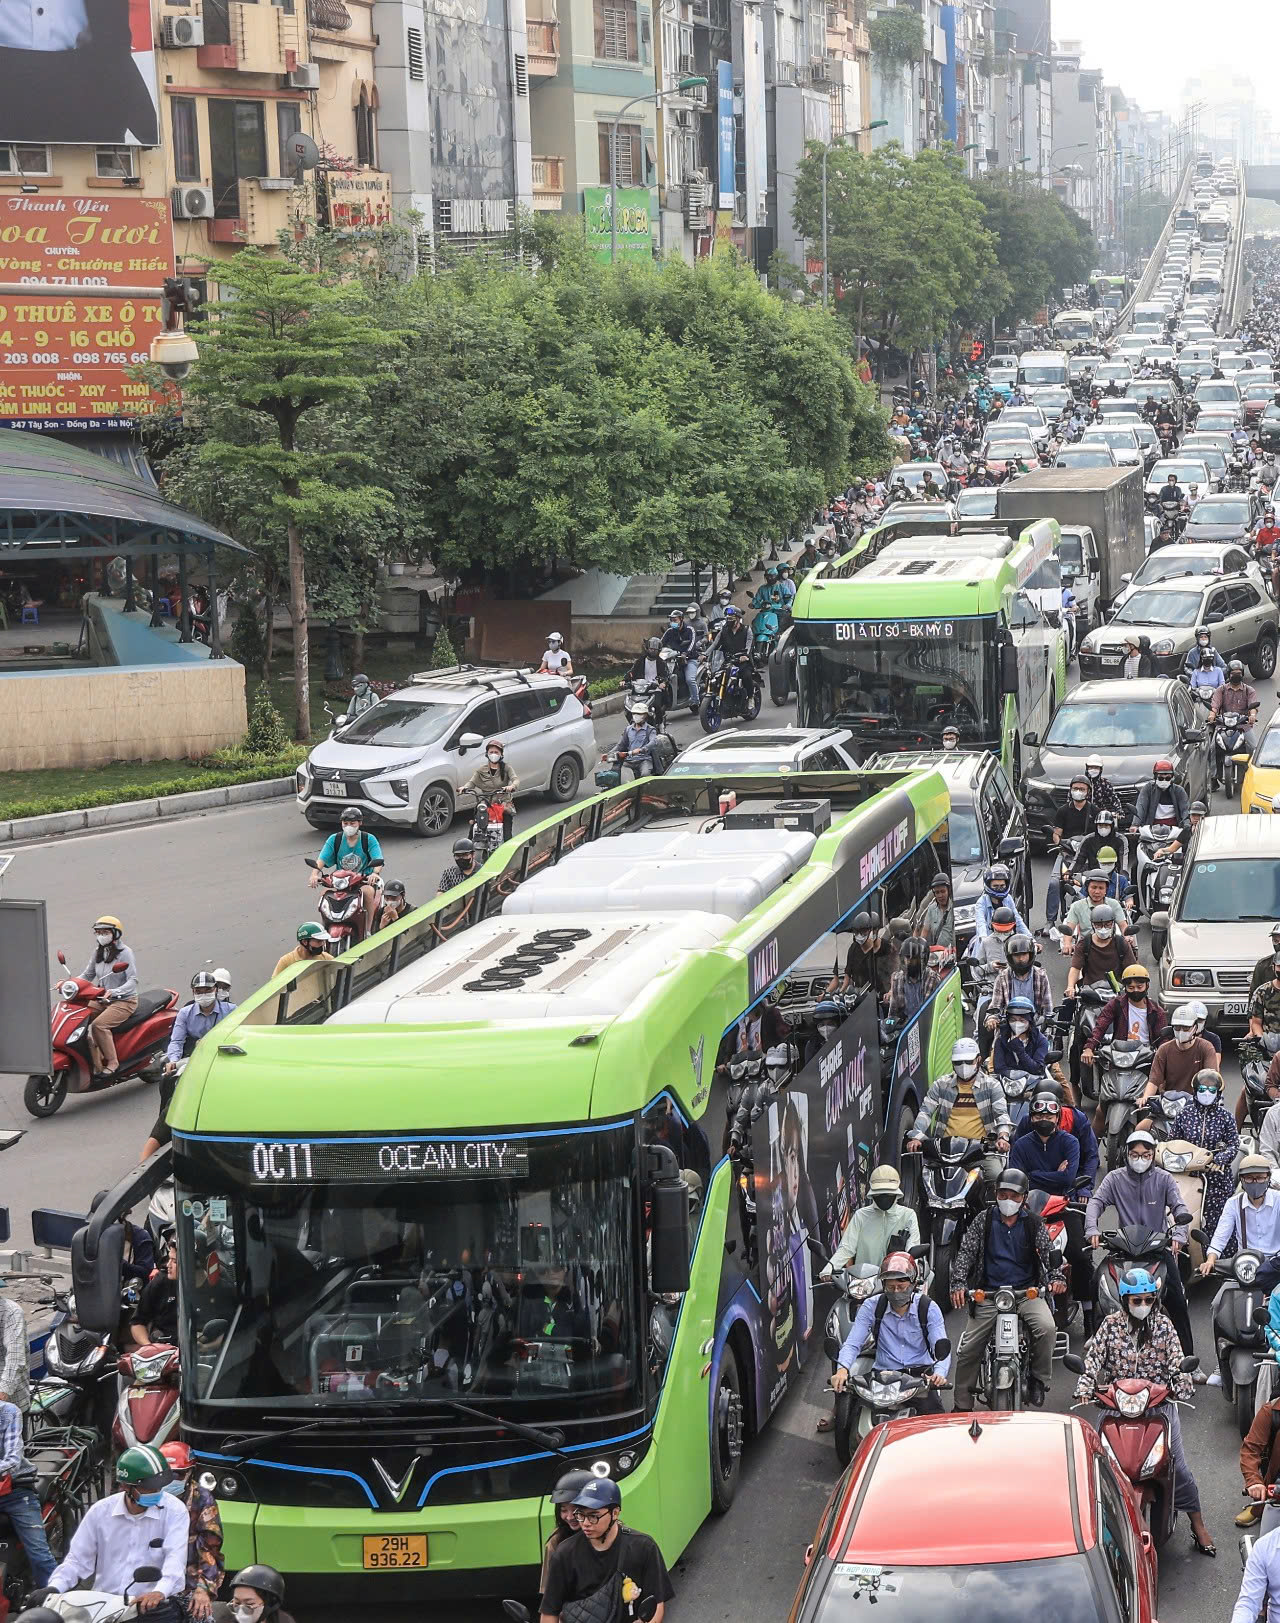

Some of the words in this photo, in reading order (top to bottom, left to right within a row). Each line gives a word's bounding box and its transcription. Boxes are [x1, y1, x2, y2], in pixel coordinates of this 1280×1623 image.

[8, 198, 67, 211] Thanh
[73, 199, 111, 214] Yến
[0, 225, 50, 244] oa
[66, 216, 161, 244] Tươi
[128, 257, 168, 270] Hiếu
[14, 300, 76, 323] THUÊ
[83, 305, 113, 322] XE
[120, 301, 136, 322] Ô
[34, 331, 49, 347] 9
[70, 331, 90, 347] 16
[96, 325, 136, 347] CHỖ
[4, 353, 28, 364] 203
[32, 353, 59, 364] 008
[73, 353, 99, 364] 098
[104, 353, 127, 364] 765
[0, 382, 16, 397] ẮC
[20, 382, 65, 397] THUỐC
[79, 385, 106, 396] XAY
[0, 399, 18, 415] ẤM
[22, 403, 51, 414] LINH
[55, 402, 76, 413] CHI
[11, 421, 26, 429] 347
[836, 624, 855, 641] E01
[910, 624, 923, 637] BX
[754, 937, 780, 995] MALTO
[820, 1040, 843, 1088] SHAKE
[379, 1145, 457, 1171] OCEAN
[464, 1143, 507, 1168] CITY
[381, 1537, 409, 1550] 29H
[370, 1552, 420, 1567] 936.22
